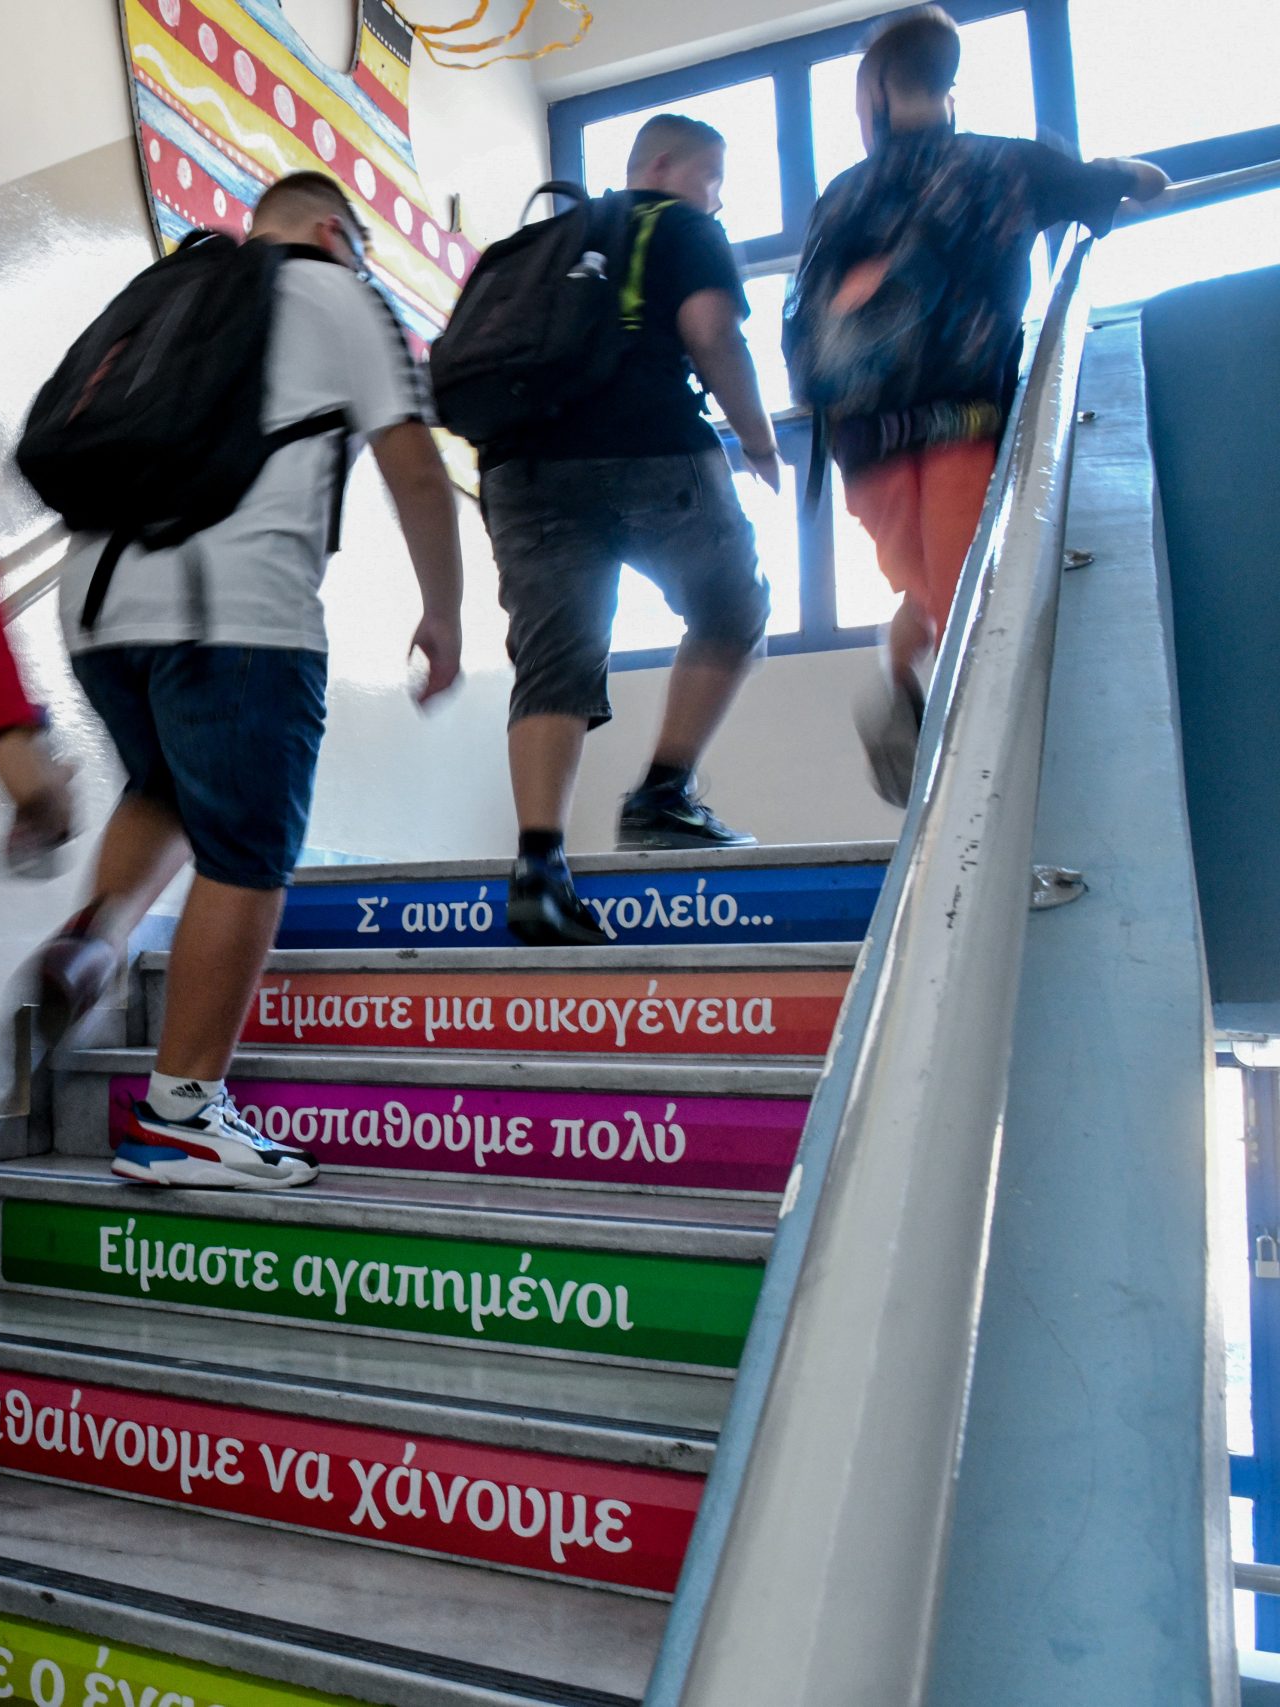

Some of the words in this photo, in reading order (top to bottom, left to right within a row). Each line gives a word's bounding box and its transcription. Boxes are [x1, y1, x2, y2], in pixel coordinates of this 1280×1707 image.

[401, 885, 493, 932] αυτό
[580, 878, 774, 940] χολείο...
[258, 979, 413, 1039] Είμαστε
[424, 996, 495, 1042] μια
[505, 979, 776, 1047] οικογένεια
[233, 1094, 534, 1167] ροσπαθούμε
[550, 1102, 686, 1164] πολύ
[98, 1217, 279, 1293] Είμαστε
[292, 1253, 634, 1332] αγαπημένοι
[258, 1443, 334, 1502] να
[348, 1442, 633, 1563] χάνουμε
[29, 1658, 66, 1707] ο
